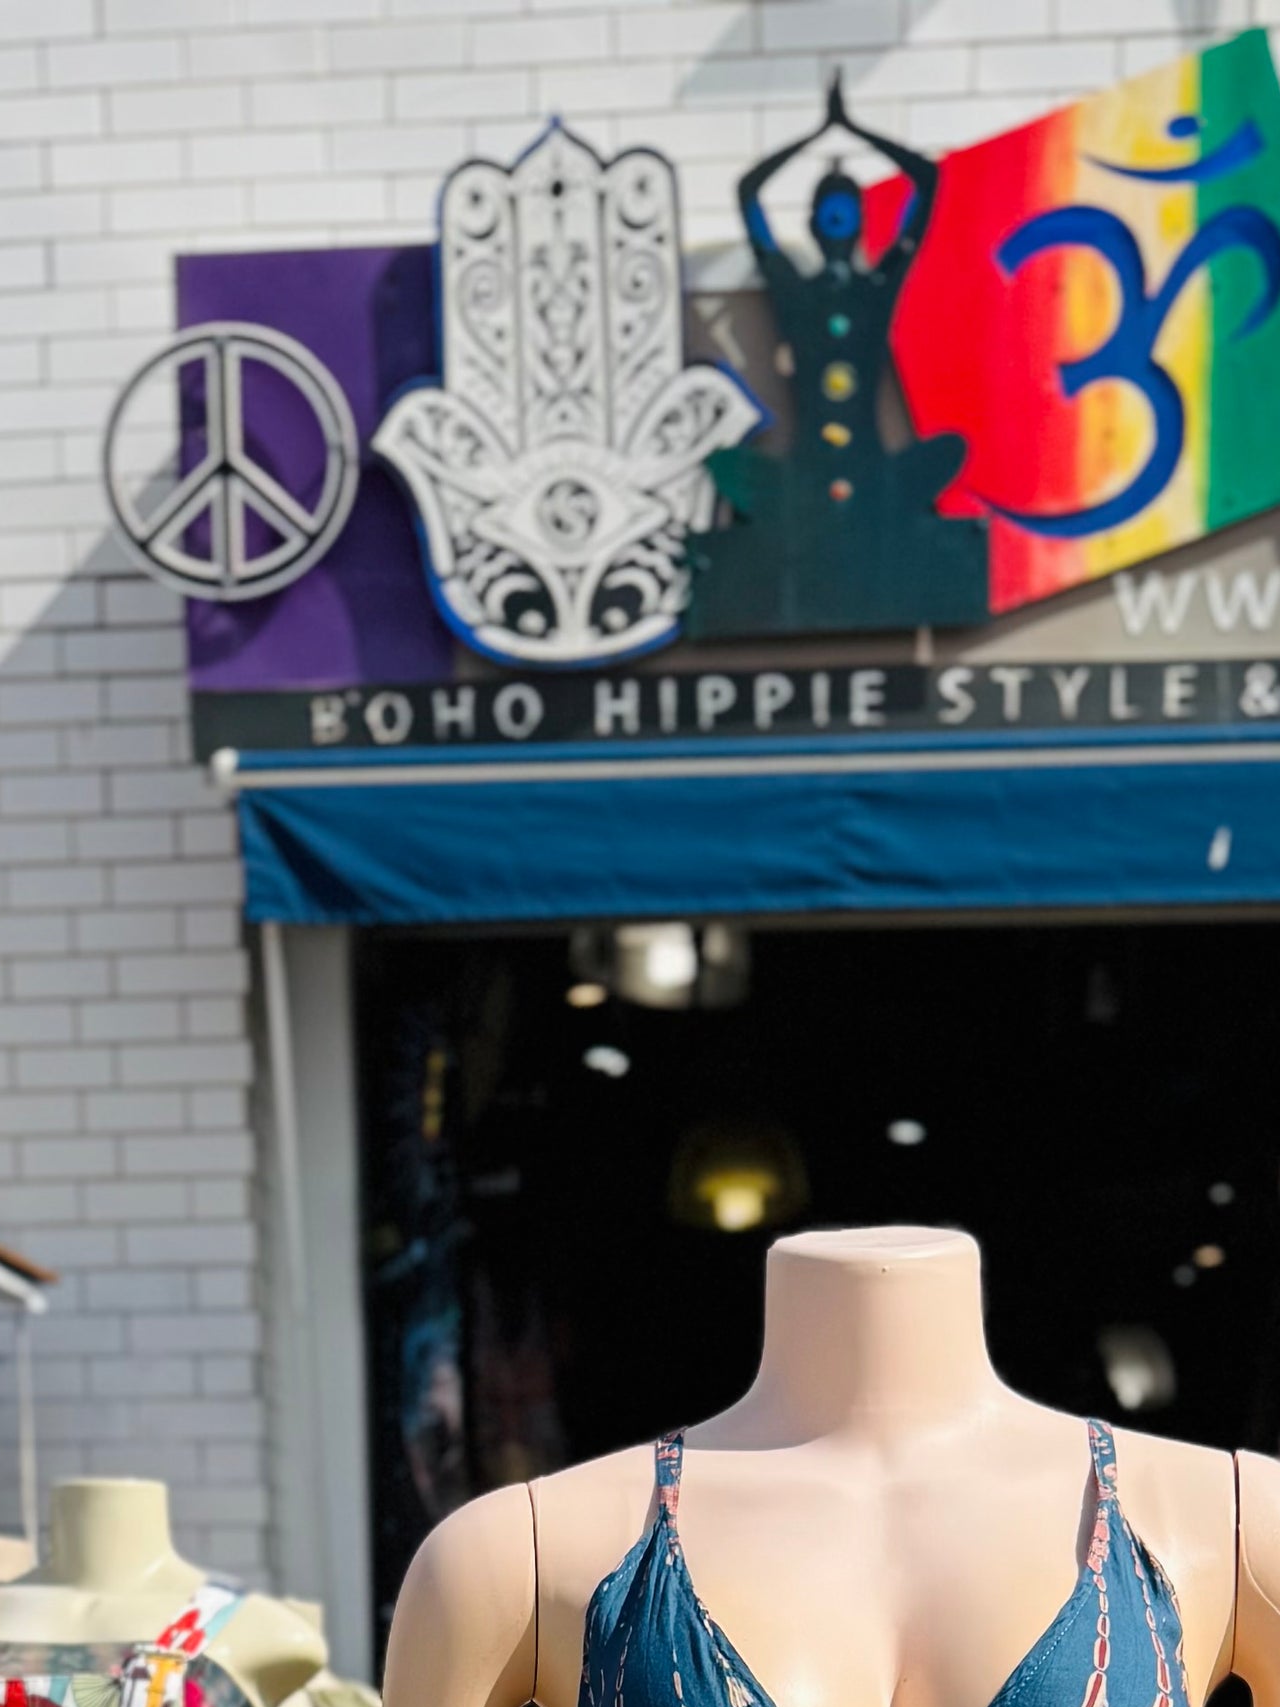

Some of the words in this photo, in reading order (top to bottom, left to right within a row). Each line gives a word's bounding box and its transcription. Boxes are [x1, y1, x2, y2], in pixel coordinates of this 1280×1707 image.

[309, 681, 545, 746] BOHO
[593, 668, 888, 738] HIPPIE
[935, 664, 1200, 725] STYLE
